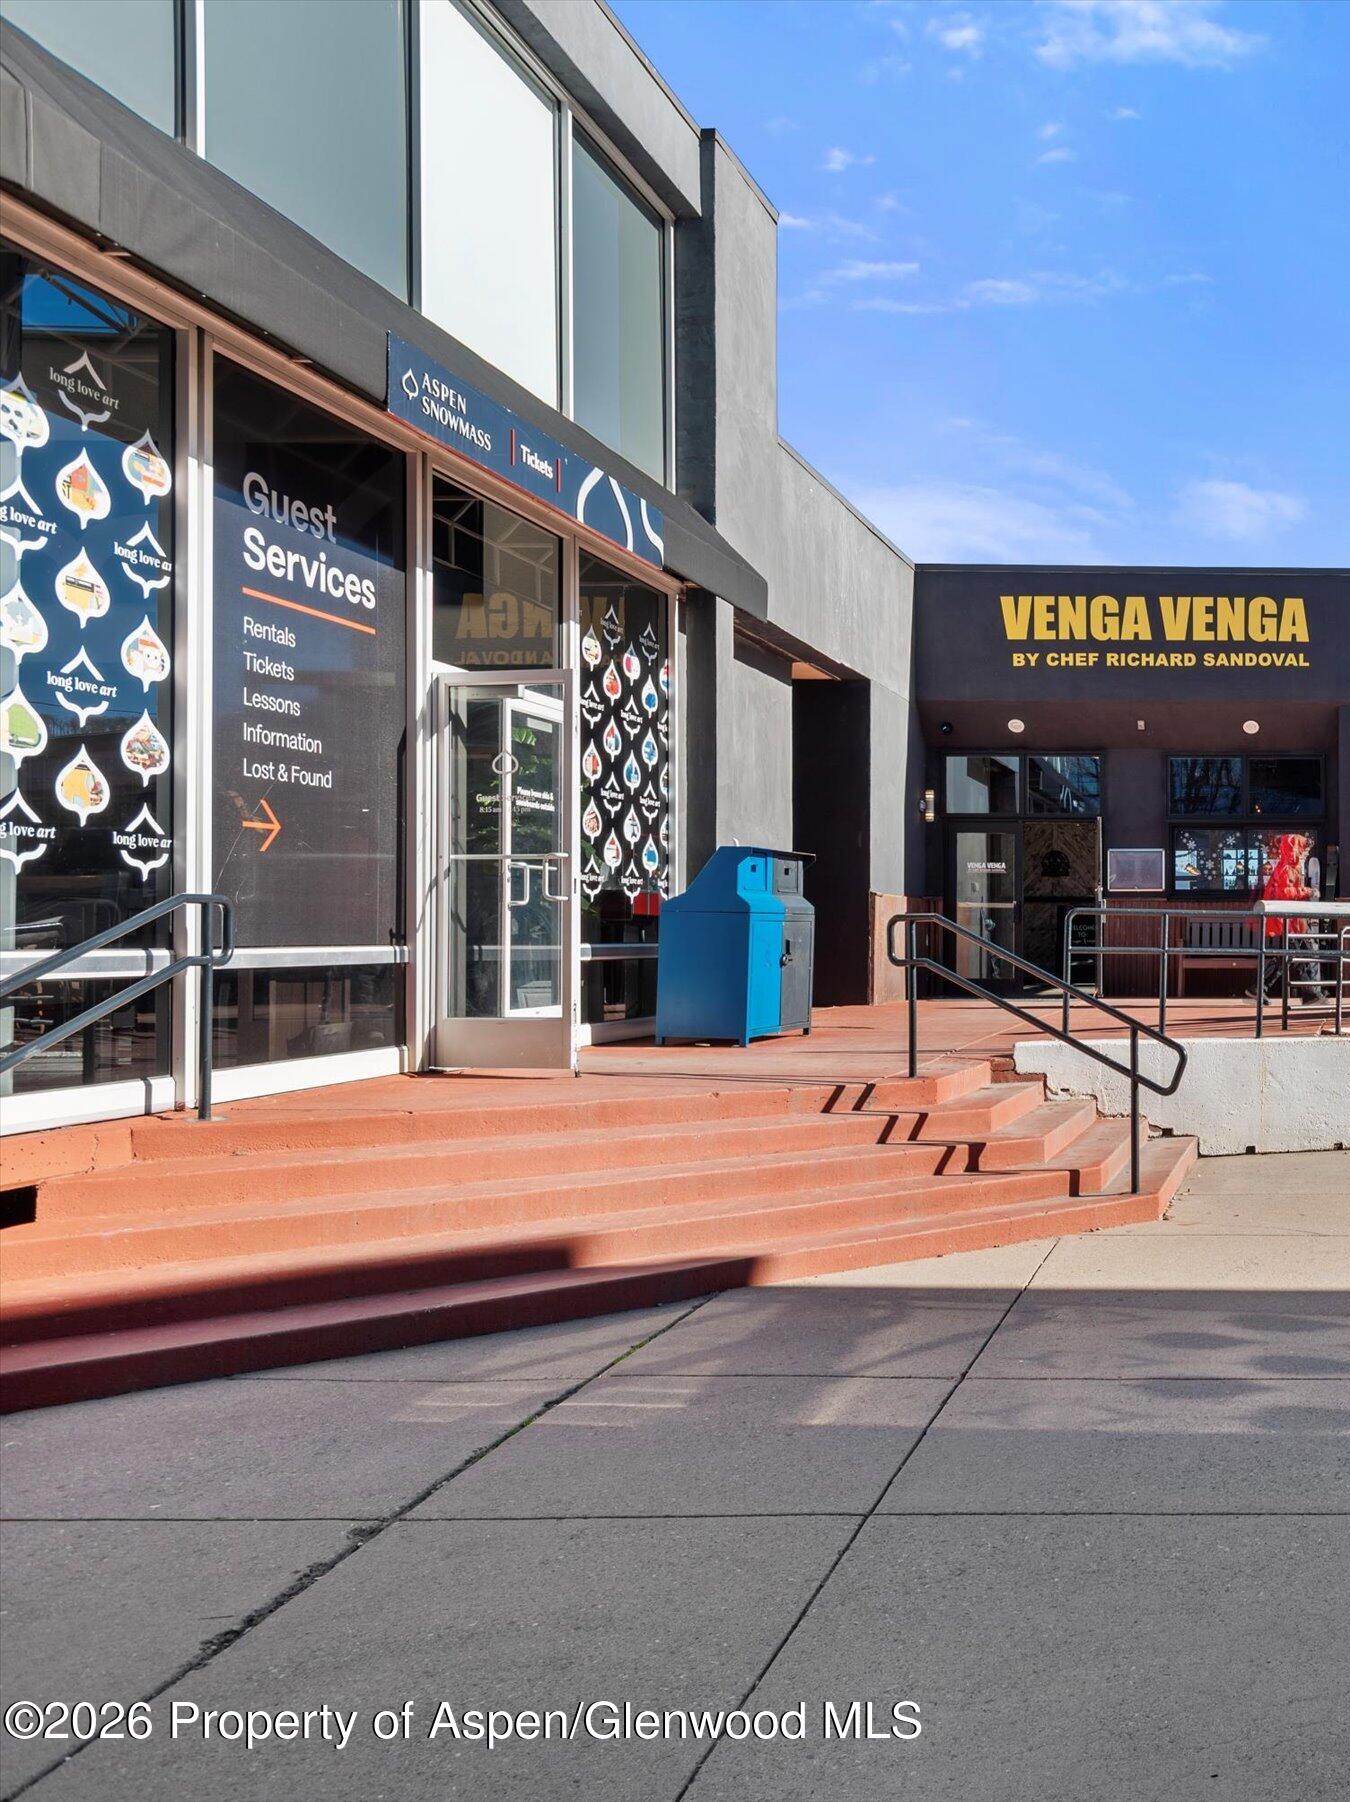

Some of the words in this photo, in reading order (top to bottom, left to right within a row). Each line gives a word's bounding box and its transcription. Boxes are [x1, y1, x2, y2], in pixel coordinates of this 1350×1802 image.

[49, 366, 75, 393] long
[77, 382, 101, 402] love
[102, 396, 120, 410] art
[422, 372, 466, 415] ASPEN
[422, 396, 492, 451] SNOWMASS
[520, 444, 554, 479] Tickets
[10, 506, 36, 528] love
[38, 520, 58, 535] art
[243, 471, 337, 544] Guest
[113, 541, 138, 563] long
[139, 550, 161, 567] love
[161, 559, 172, 572] ar
[243, 527, 376, 609] Services
[243, 616, 296, 648] Rentals
[1000, 595, 1152, 641] VENGA
[1159, 596, 1310, 643] VENGA
[243, 651, 295, 681] Tickets
[1013, 652, 1039, 667] BY
[1046, 652, 1099, 667] CHEF
[1106, 652, 1197, 668] RICHARD
[1203, 652, 1310, 668] SANDOVAL
[47, 671, 73, 692] long
[75, 678, 98, 694] love
[100, 684, 117, 697] art
[243, 687, 301, 716] Lessons
[243, 722, 322, 754] Information
[243, 758, 274, 781] Lost
[277, 764, 288, 782] &
[291, 766, 332, 789] Found
[9, 821, 36, 837] love
[36, 825, 56, 839] art
[112, 831, 137, 849] long
[138, 834, 160, 848] love
[160, 838, 172, 848] ar
